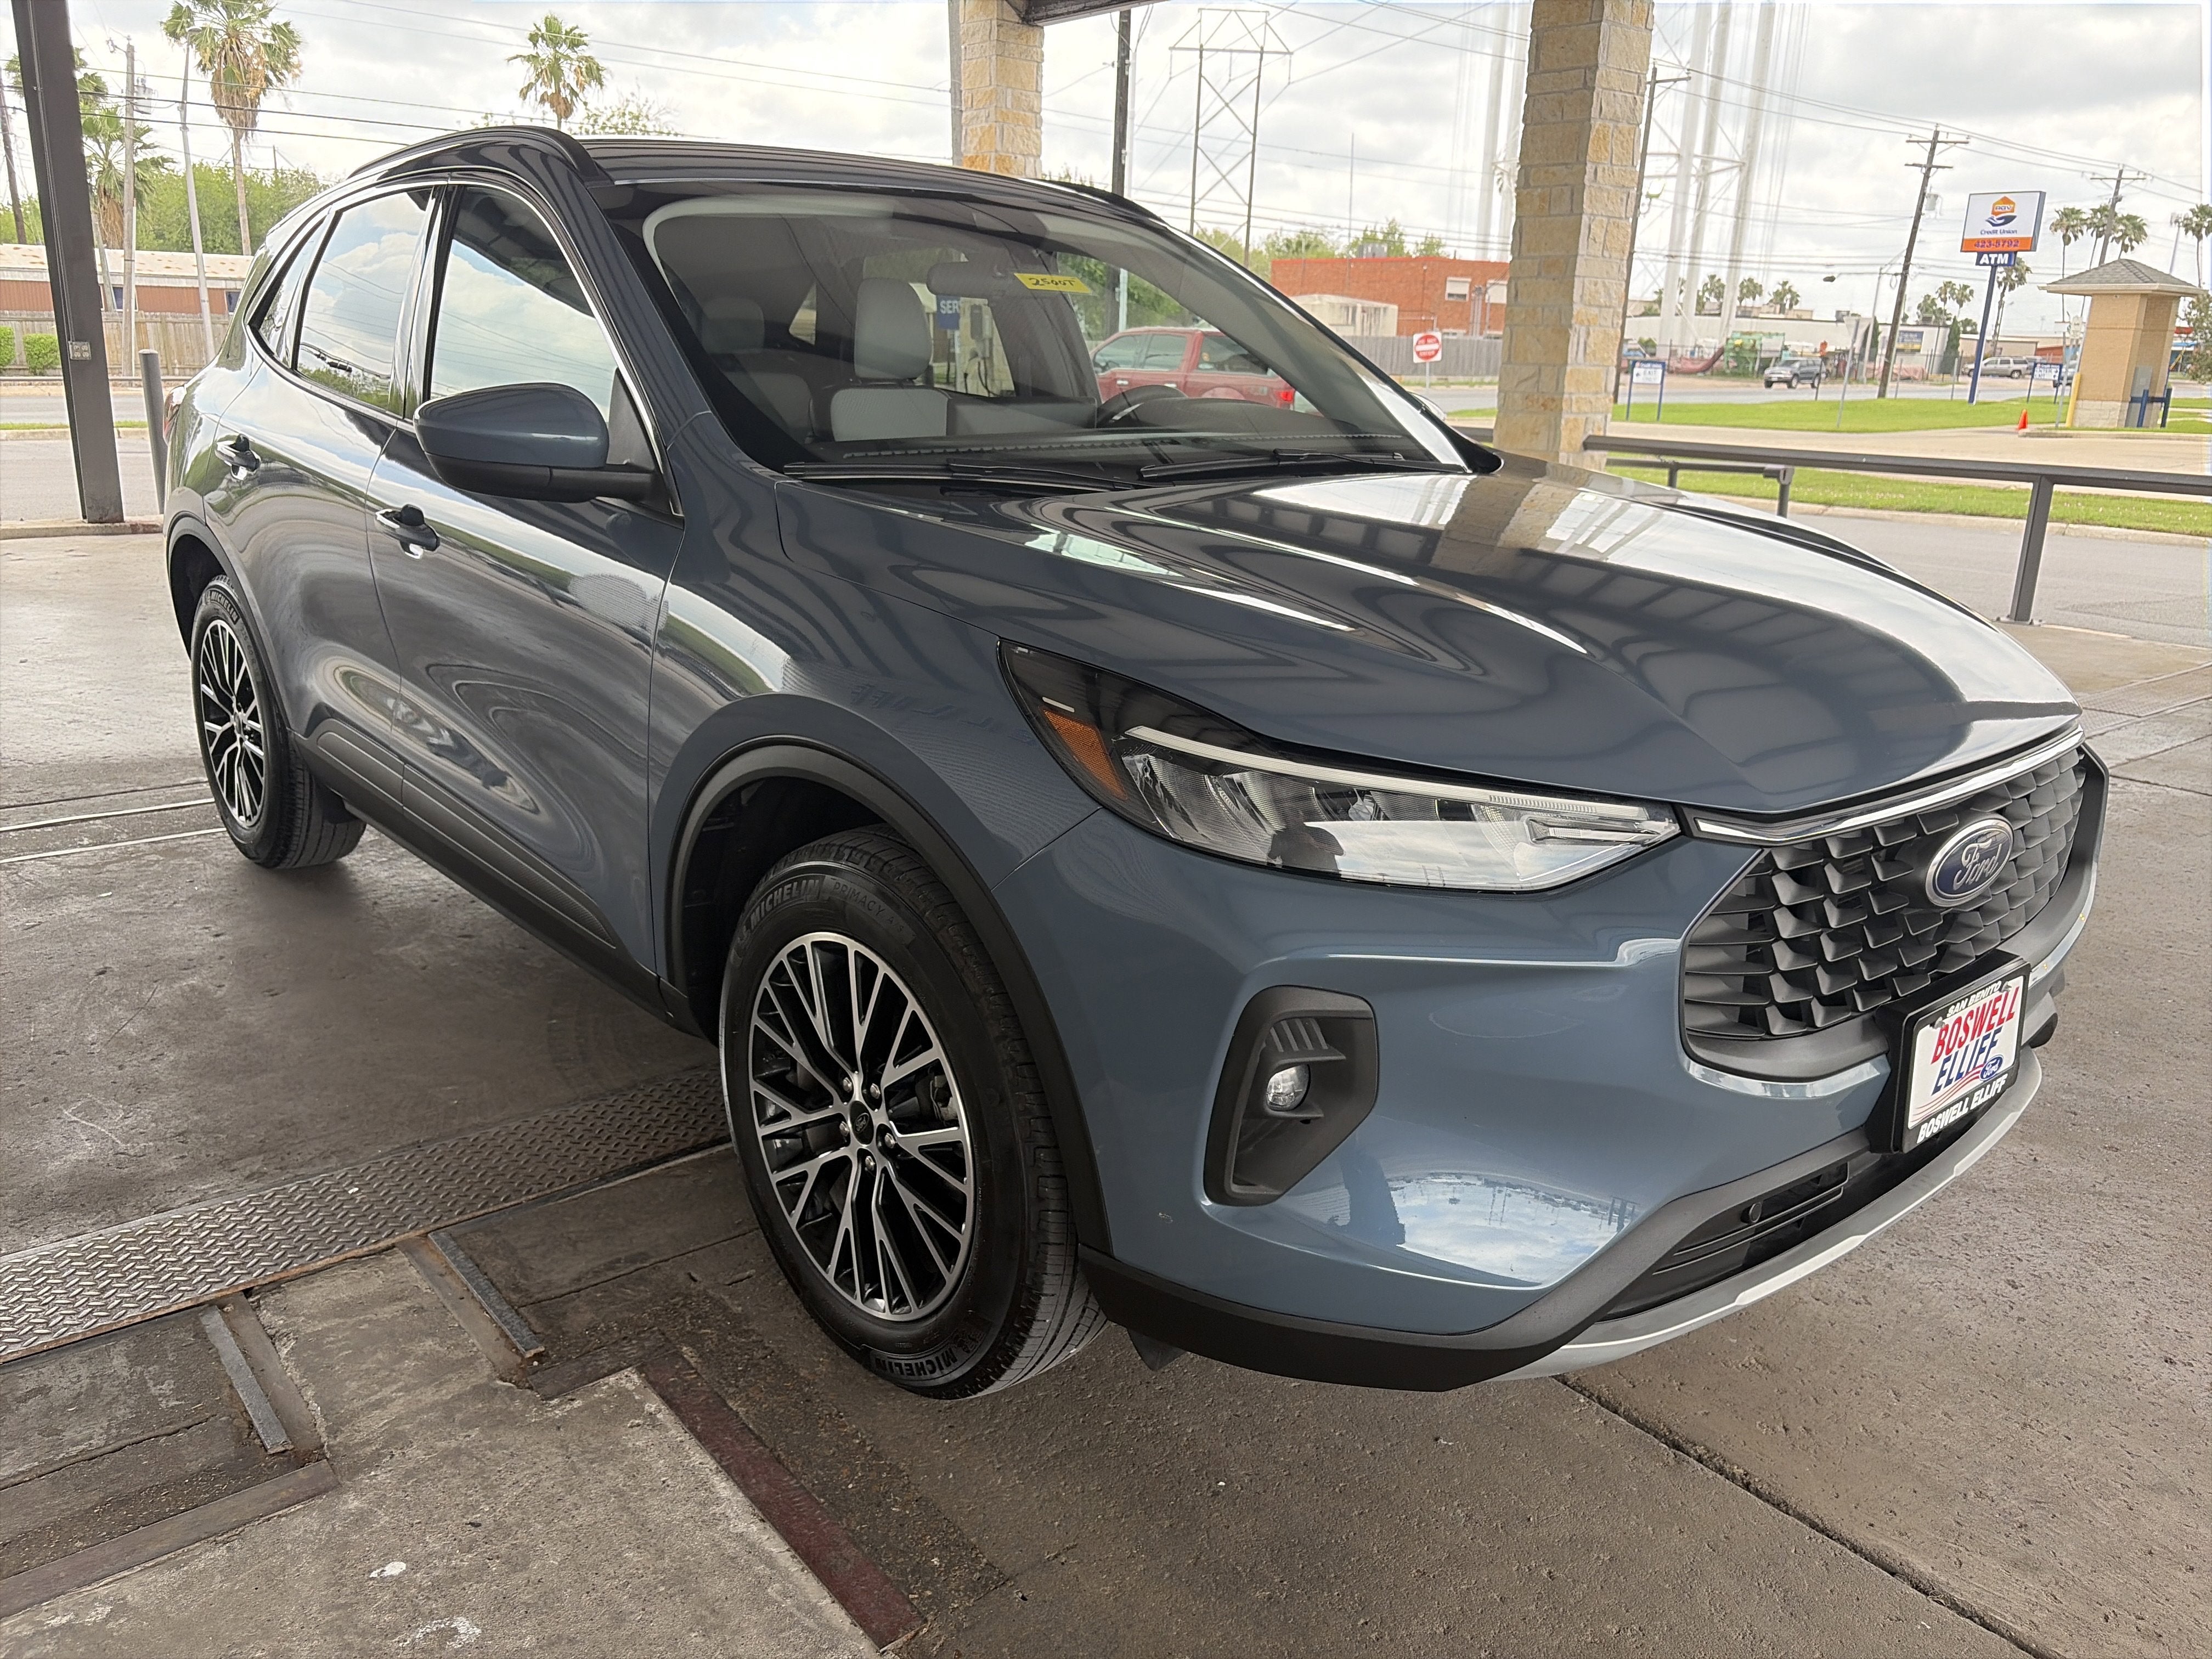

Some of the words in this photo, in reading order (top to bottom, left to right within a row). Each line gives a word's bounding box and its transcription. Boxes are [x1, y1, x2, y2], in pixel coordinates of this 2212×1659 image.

[1974, 239, 2019, 248] 423-5792
[1979, 253, 2009, 264] ATM
[211, 591, 239, 622] MICHELIN
[1953, 838, 2002, 890] Ford
[751, 879, 820, 930] MICHELIN
[832, 881, 886, 916] PRIMACY
[1947, 997, 1968, 1017] SAN
[1968, 980, 2002, 1007] BENITO
[1931, 986, 2019, 1065] BOSWELL
[1931, 1027, 2003, 1096] ELLIFF
[1916, 1097, 1970, 1144] BOSWELL
[1970, 1073, 2008, 1110] ELLIFF
[874, 1346, 958, 1376] MICHELIN
